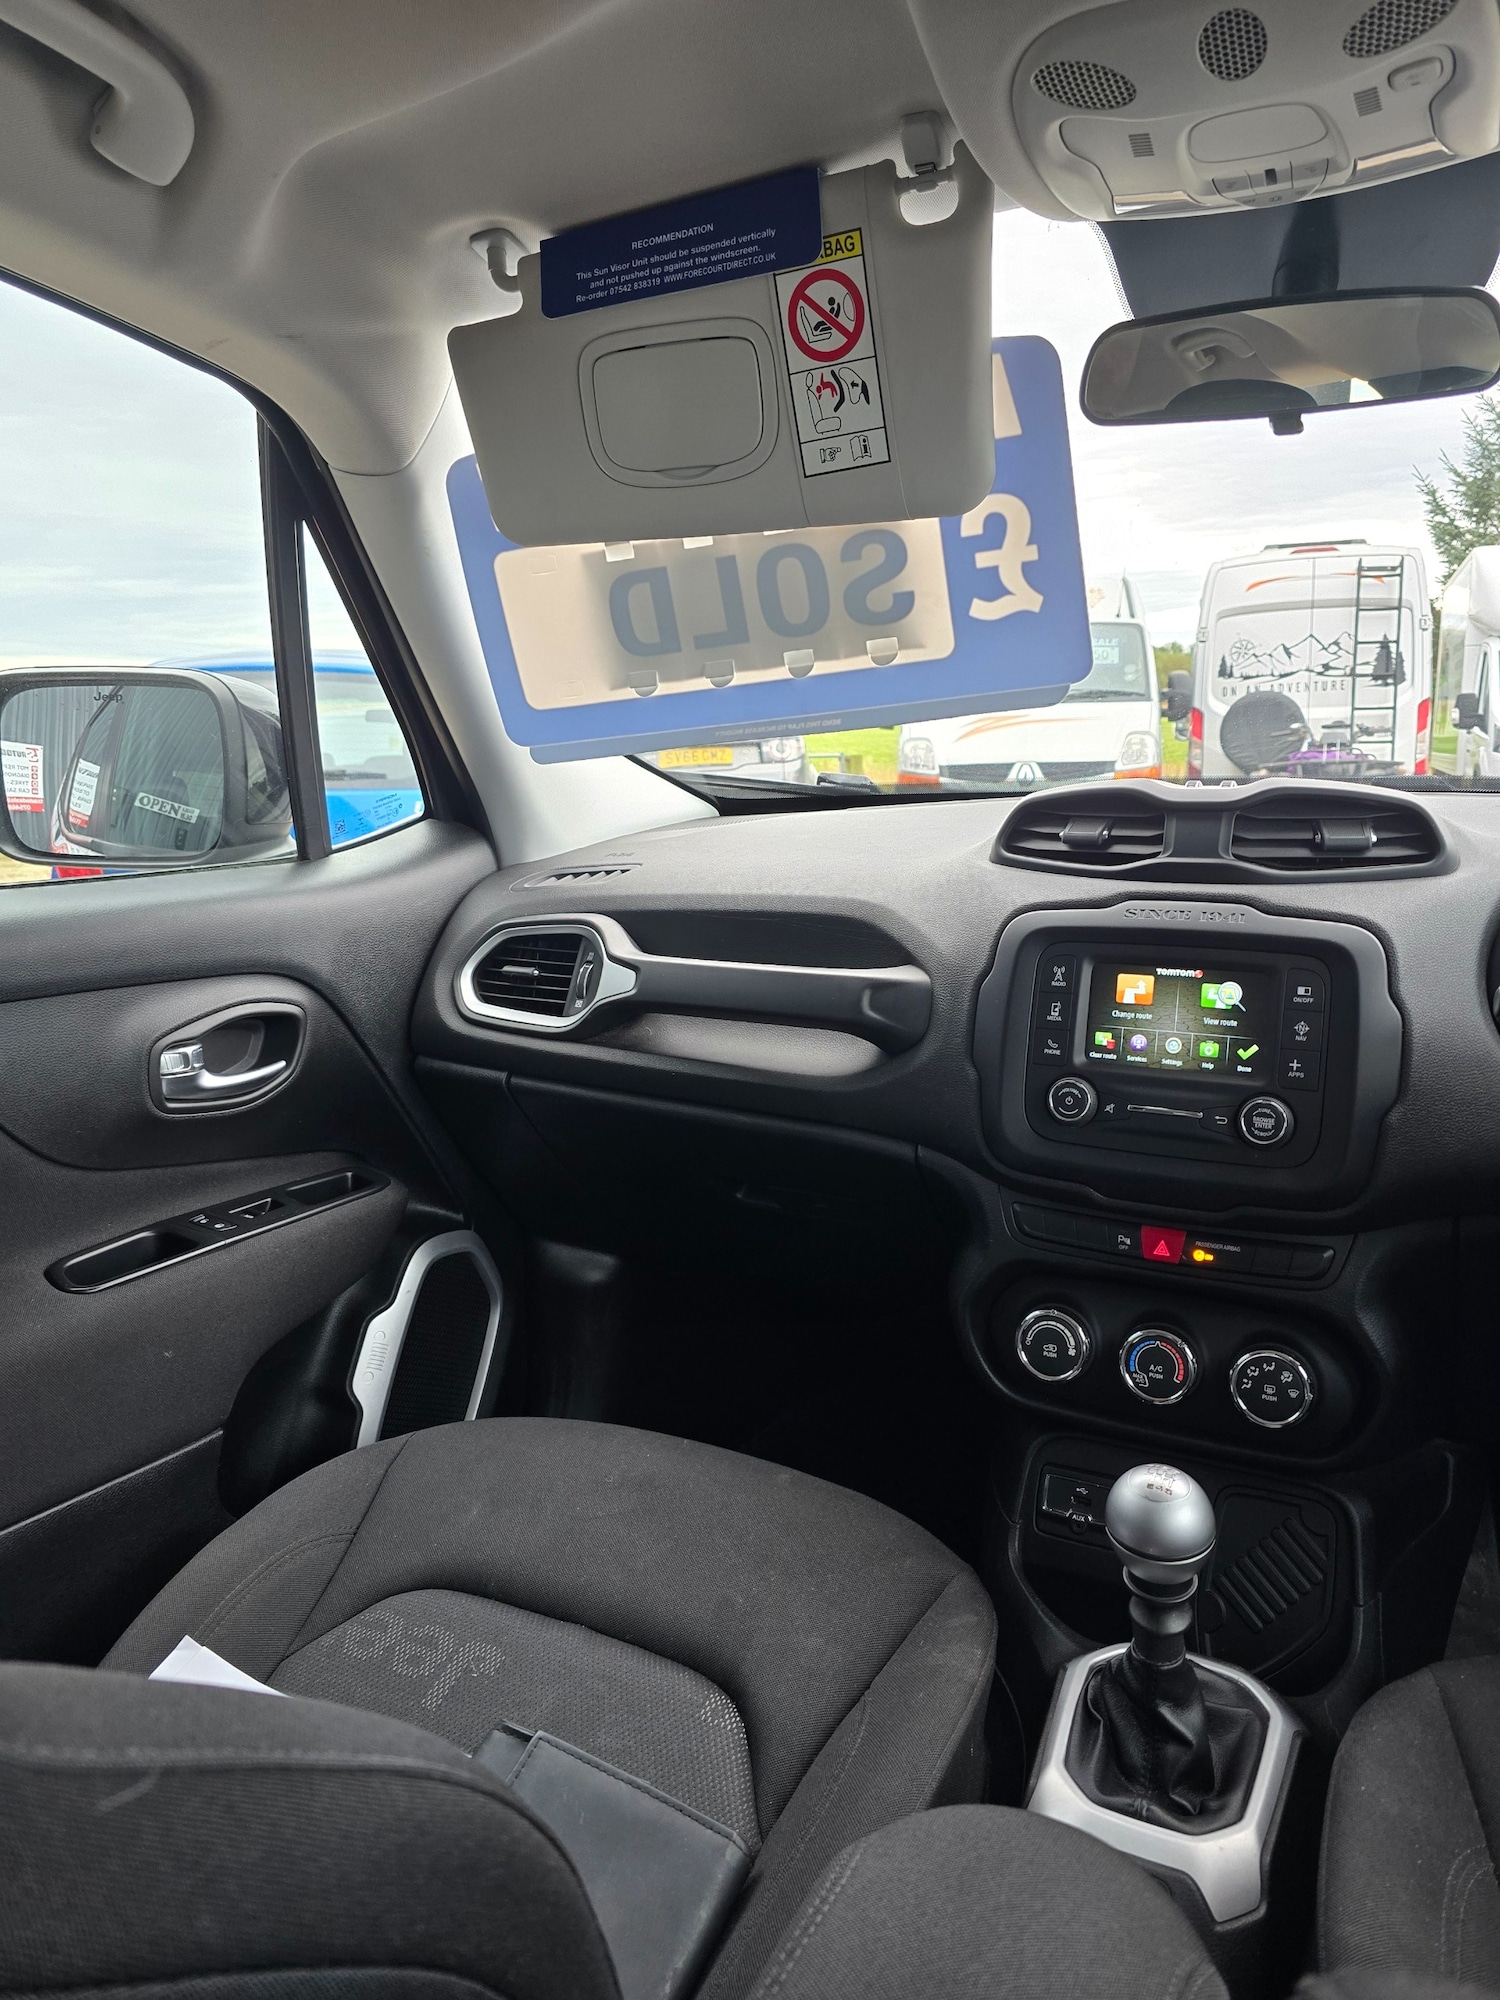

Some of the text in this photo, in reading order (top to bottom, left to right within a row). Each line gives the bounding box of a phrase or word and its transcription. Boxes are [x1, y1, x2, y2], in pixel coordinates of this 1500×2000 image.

[632, 223, 714, 250] RECOMMENDATION
[594, 268, 608, 277] Sun
[610, 263, 630, 272] Visor
[632, 258, 648, 267] Unit
[650, 250, 676, 264] should
[679, 249, 689, 257] be
[691, 237, 736, 253] suspended
[738, 228, 776, 243] vertically
[820, 235, 855, 258] BAG
[606, 276, 619, 284] not
[620, 268, 650, 283] pushed
[664, 259, 693, 272] against
[695, 256, 708, 265] the
[710, 245, 761, 262] windscreen.
[576, 252, 776, 302] Re-order 07542 838319 WWW.FORECOURTDIRECT.CO.UK
[1222, 686, 1238, 697] ON
[1270, 680, 1346, 693] ADVENTURE
[94, 692, 123, 703] Jeep
[139, 795, 182, 817] OPEN
[1123, 907, 1247, 924] SINCE 1941
[1112, 1010, 1134, 1019] Change
[1203, 1017, 1218, 1026] View
[1161, 1058, 1183, 1067] Settings
[1195, 1241, 1223, 1249] PASSENGER
[1261, 1394, 1278, 1402] PUSH
[1072, 1514, 1085, 1522] AUX
